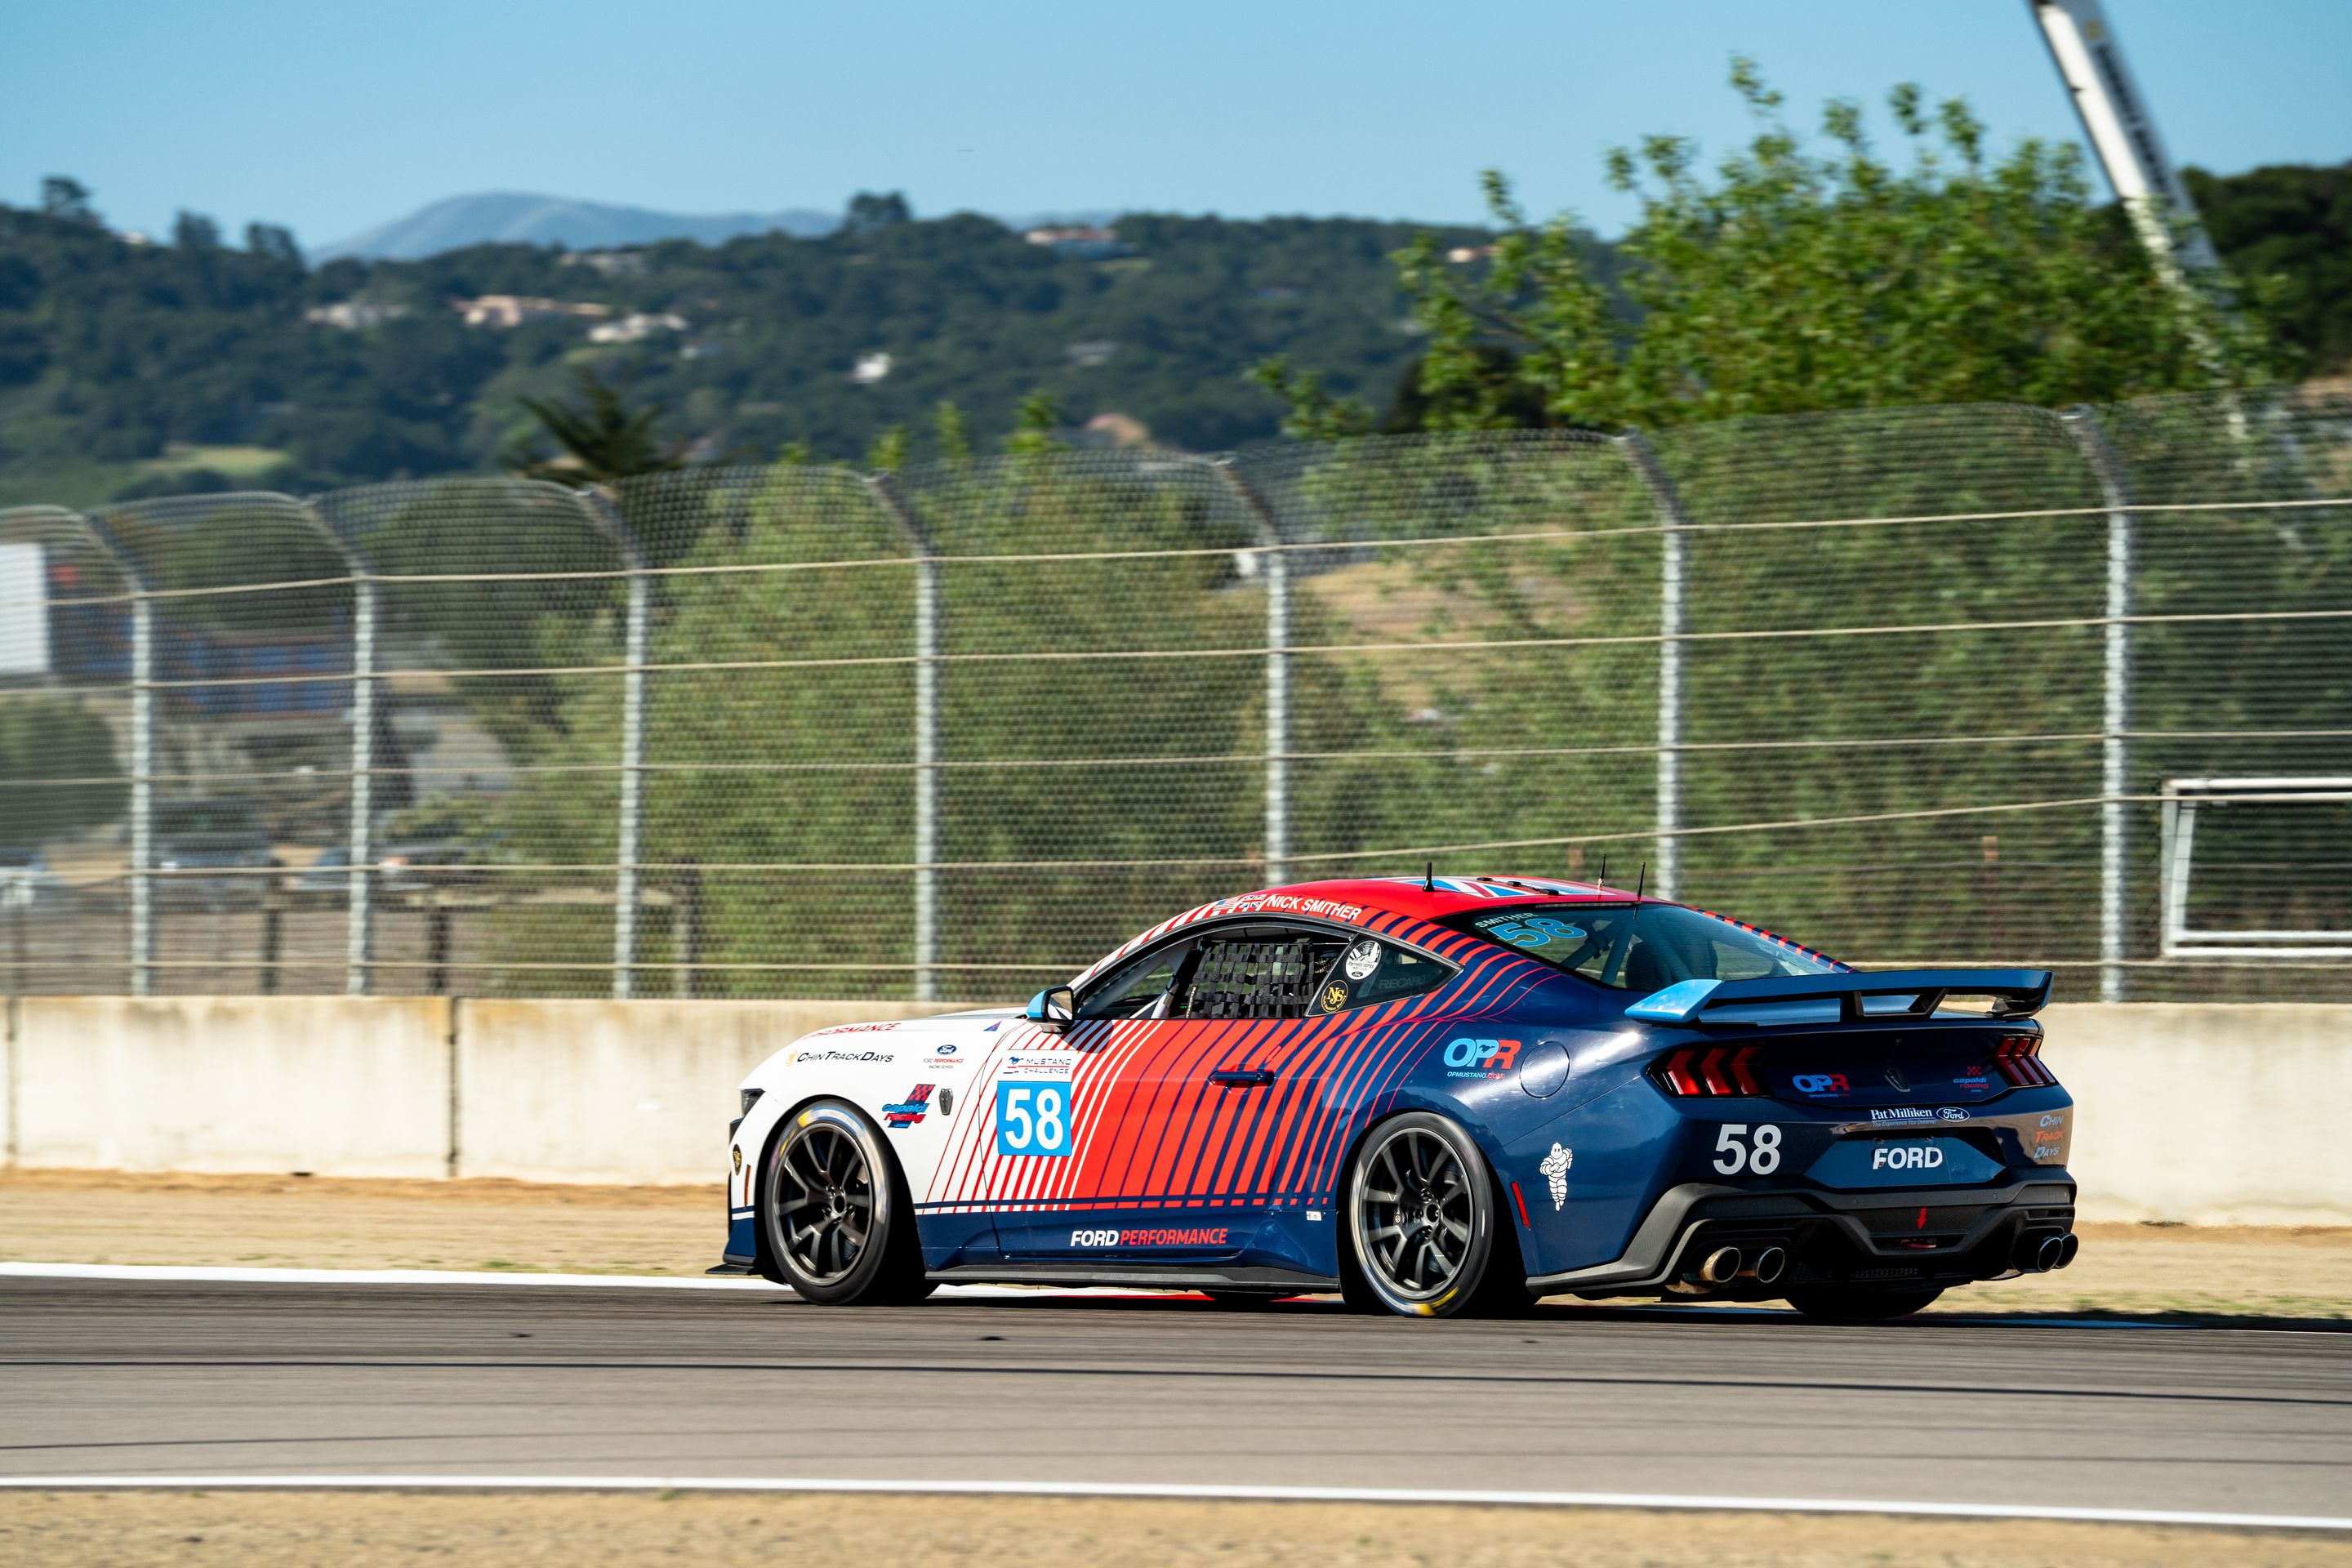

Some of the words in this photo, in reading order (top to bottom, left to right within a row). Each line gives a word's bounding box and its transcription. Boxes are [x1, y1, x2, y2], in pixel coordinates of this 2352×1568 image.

[1266, 894, 1303, 910] NICK
[1302, 898, 1362, 920] SMITHER
[1475, 912, 1539, 928] SMITHER
[1488, 918, 1588, 947] 58
[1444, 1038, 1521, 1070] OPR
[1793, 1074, 1851, 1093] OPR
[882, 1103, 929, 1113] capaldi
[1870, 1109, 1888, 1120] Pat
[1887, 1107, 1933, 1119] Milliken
[1943, 1108, 1965, 1120] Ford
[884, 1112, 926, 1124] racing
[1004, 1089, 1063, 1150] 58
[2039, 1114, 2064, 1127] CHIN
[2035, 1129, 2065, 1143] TRACK
[1713, 1124, 1782, 1175] 58
[1873, 1147, 1943, 1169] FORD
[2034, 1146, 2060, 1159] DAYS
[1070, 1230, 1119, 1247] FORD
[1119, 1227, 1228, 1245] PERFORMANCE
